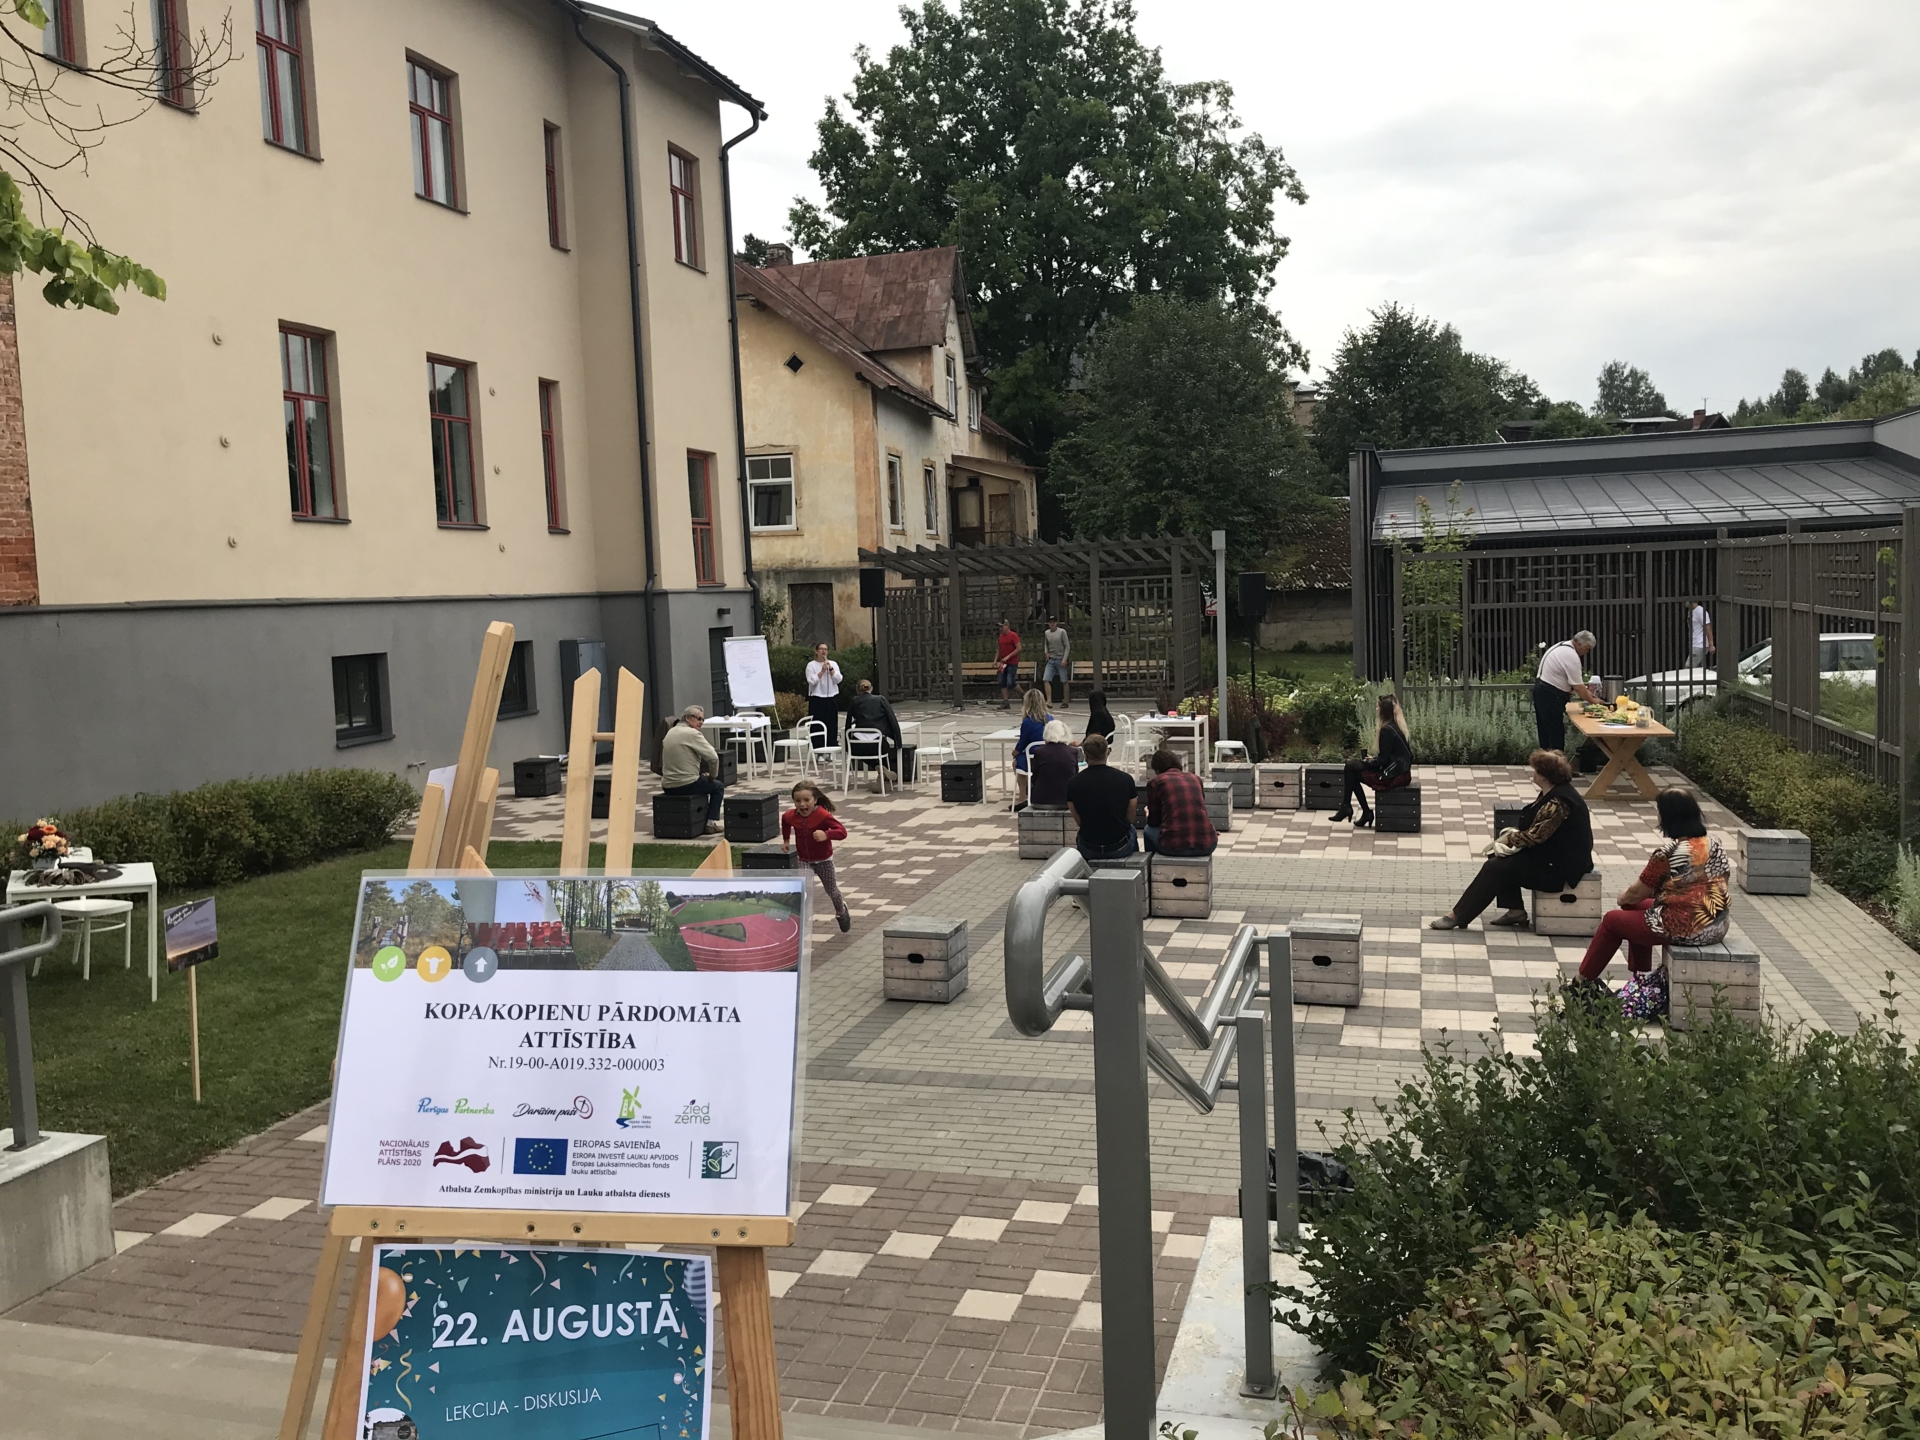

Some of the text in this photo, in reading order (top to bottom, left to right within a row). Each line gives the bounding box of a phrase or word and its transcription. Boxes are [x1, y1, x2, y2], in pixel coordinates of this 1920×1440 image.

[424, 1002, 741, 1023] KOPA/KOPIENU PĀRDOMĀTA
[519, 1029, 636, 1049] ATTĪSTĪBA
[488, 1056, 665, 1071] Nr.19-00-A019.332-000003
[674, 1100, 711, 1125] zied zeme
[379, 1140, 430, 1148] NACIONĀLAIS
[573, 1139, 661, 1150] EIROPAS SAVIENĪBA
[379, 1149, 422, 1157] ATTĪSTĪBAS
[572, 1152, 679, 1161] EIROPA INVESTĒ LAUKU APVIDOS
[378, 1158, 401, 1166] PLĀNS
[572, 1160, 595, 1169] Eiropas
[652, 1161, 670, 1169] fonds
[439, 1185, 472, 1194] Atbalsta
[474, 1185, 522, 1196] Zemkopības
[524, 1187, 563, 1197] ministrija
[577, 1188, 603, 1197] Lauku
[605, 1189, 636, 1198] atbalsta
[639, 1189, 671, 1199] dienests
[433, 1293, 682, 1348] 22. AUGUSTĀ
[446, 1401, 509, 1422] LEKCIJA
[524, 1387, 602, 1412] DISKUSIJA
